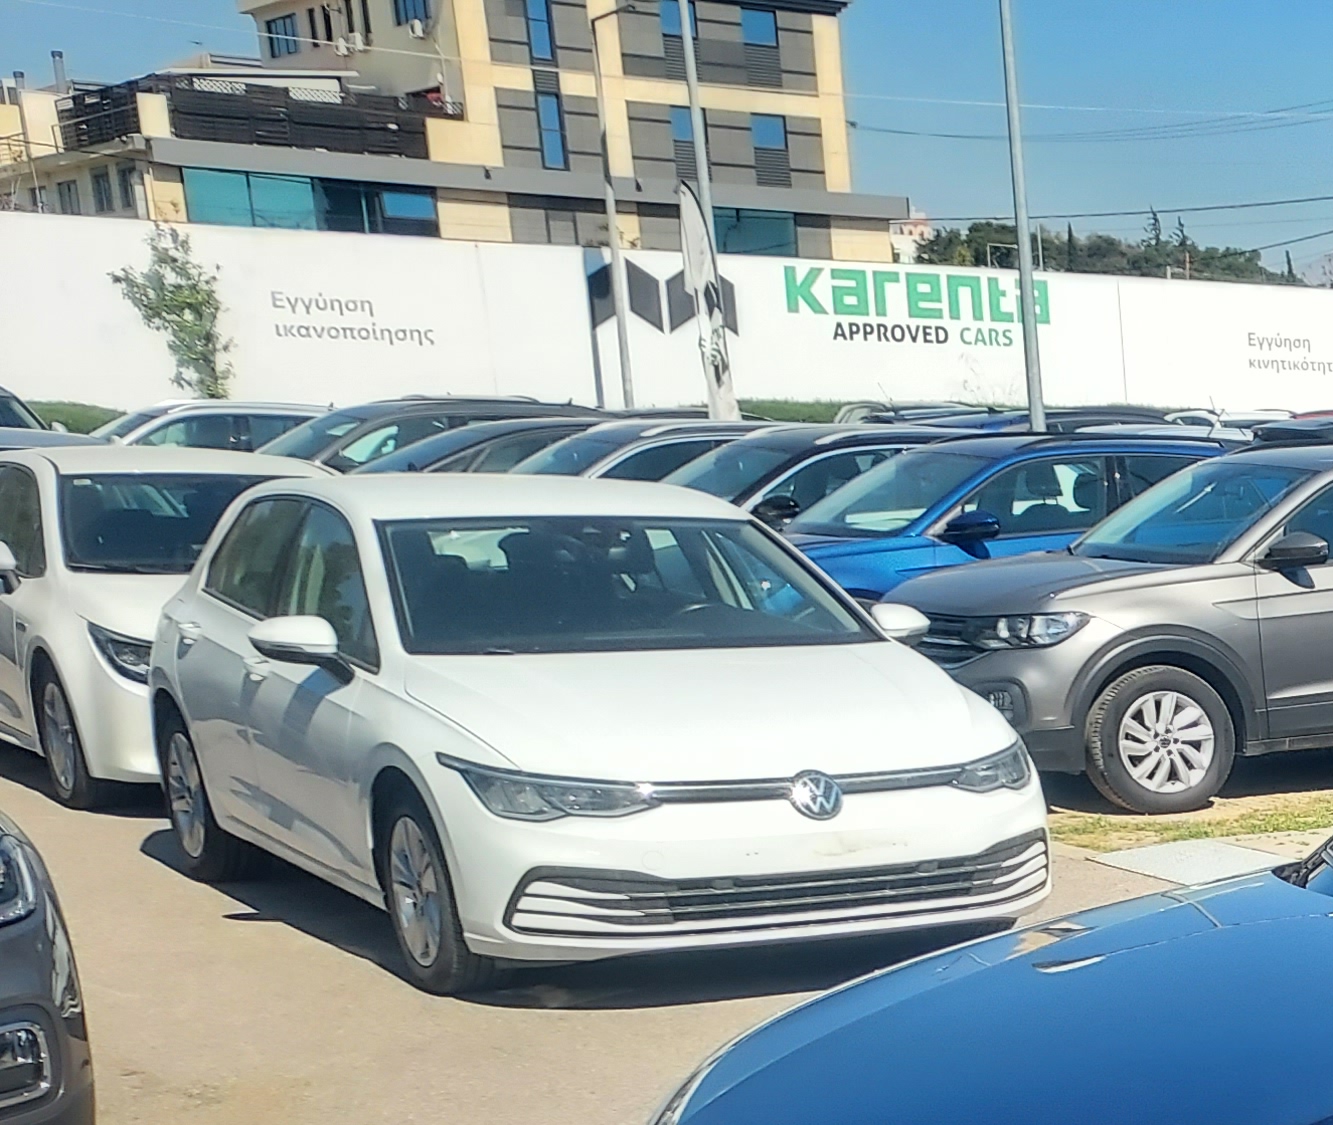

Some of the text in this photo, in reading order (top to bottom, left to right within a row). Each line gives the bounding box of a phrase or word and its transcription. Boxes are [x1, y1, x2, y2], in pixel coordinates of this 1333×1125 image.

[271, 290, 375, 317] Εγγύηση
[275, 322, 435, 346] ικανοποίησης
[833, 322, 1014, 347] APPROVED CARS
[1248, 332, 1311, 353] Εγγύηση
